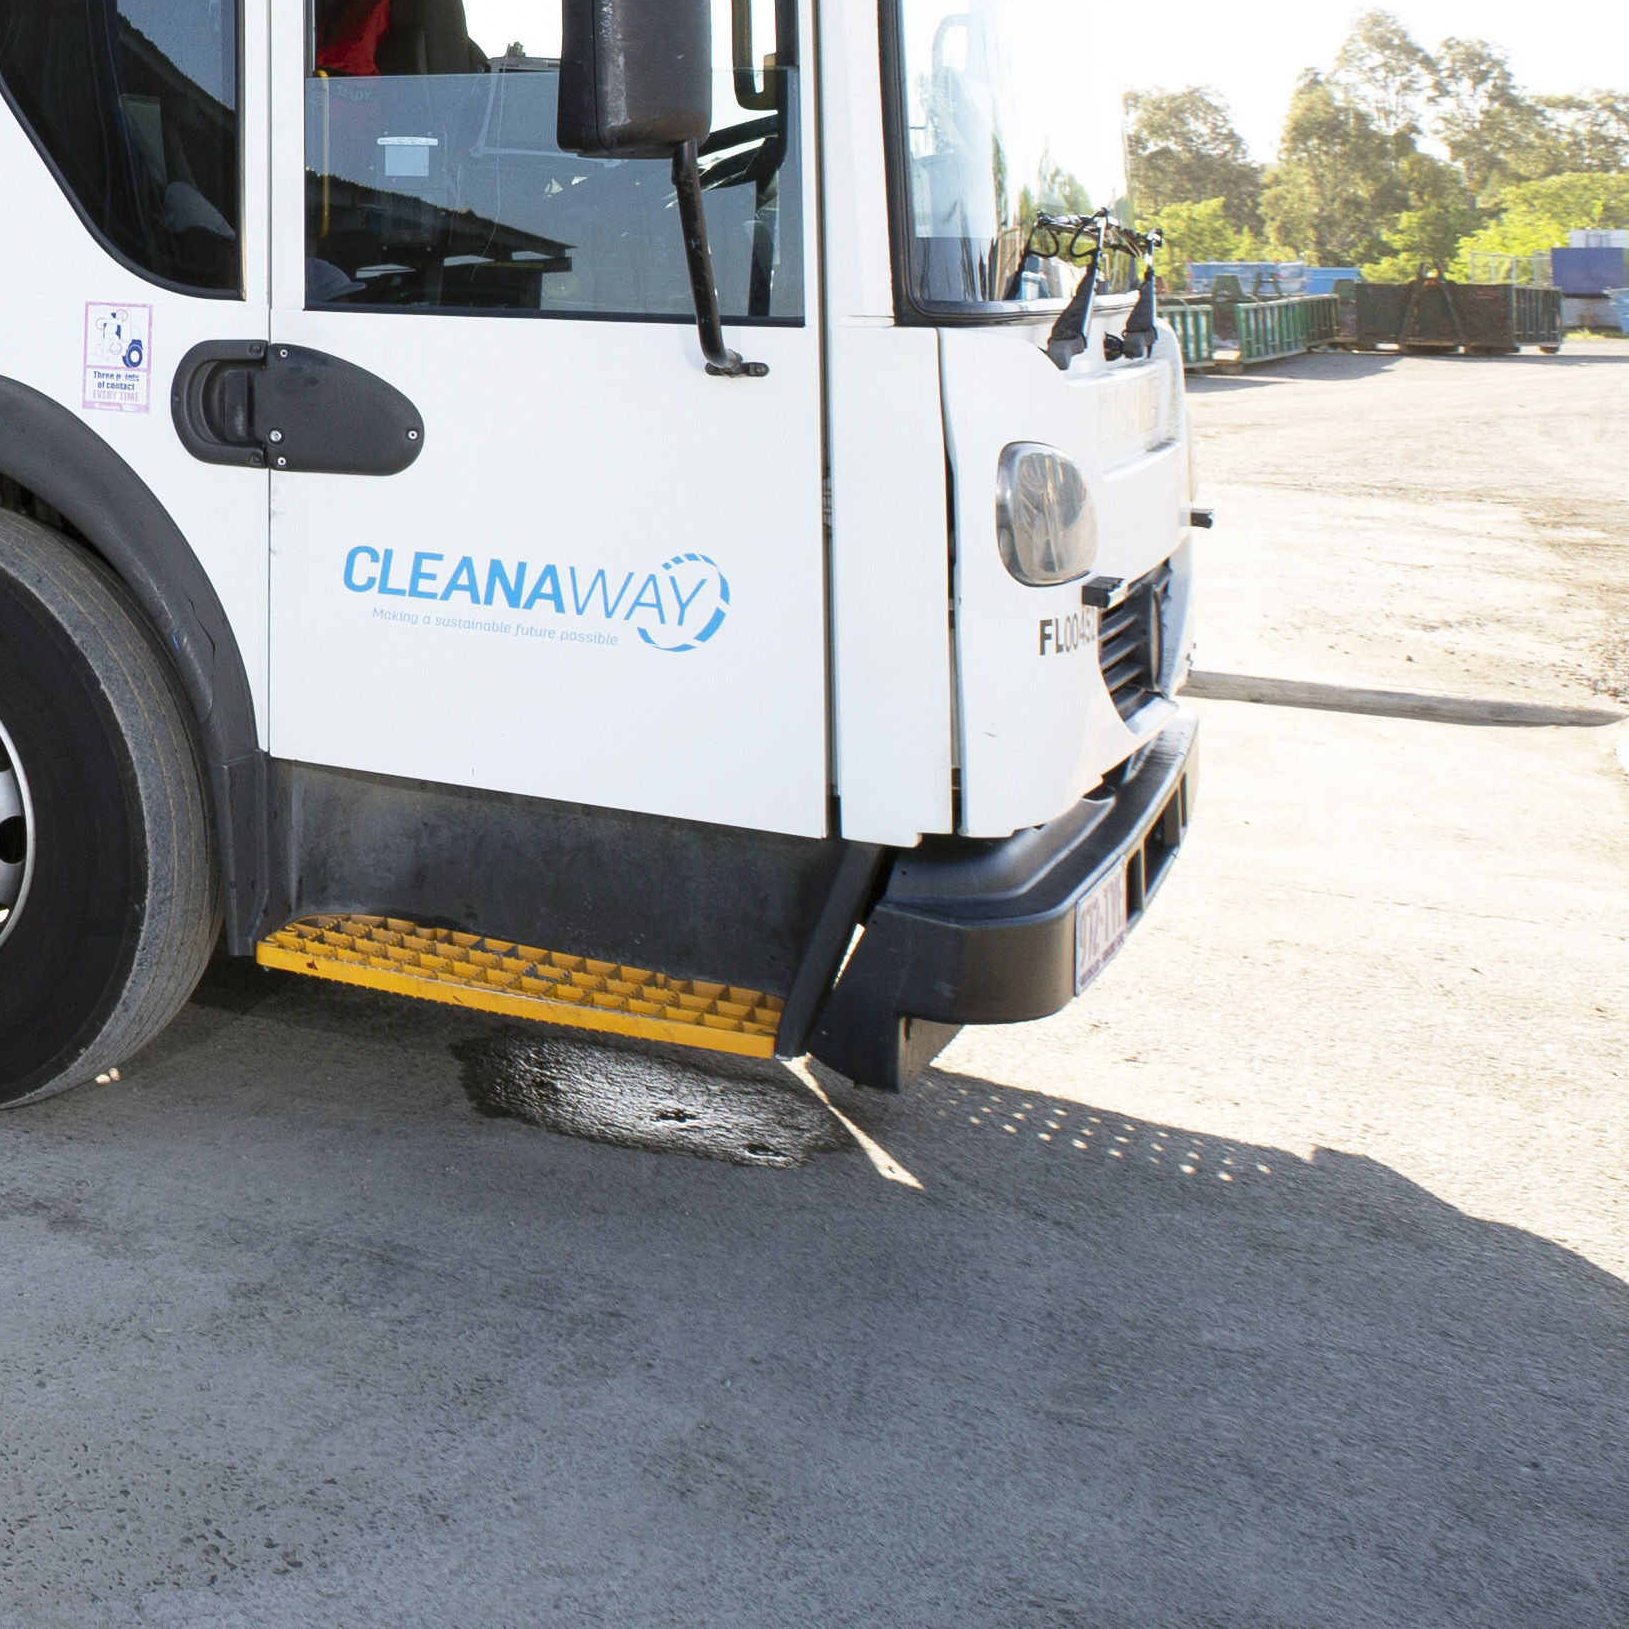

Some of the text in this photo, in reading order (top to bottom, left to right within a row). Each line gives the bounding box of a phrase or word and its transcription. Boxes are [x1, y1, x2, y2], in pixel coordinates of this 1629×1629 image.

[93, 371, 140, 382] Three pints
[93, 390, 139, 402] EVERY TIME
[343, 545, 707, 626] CLEANAWAY
[372, 607, 619, 647] Making a sustainable future possible
